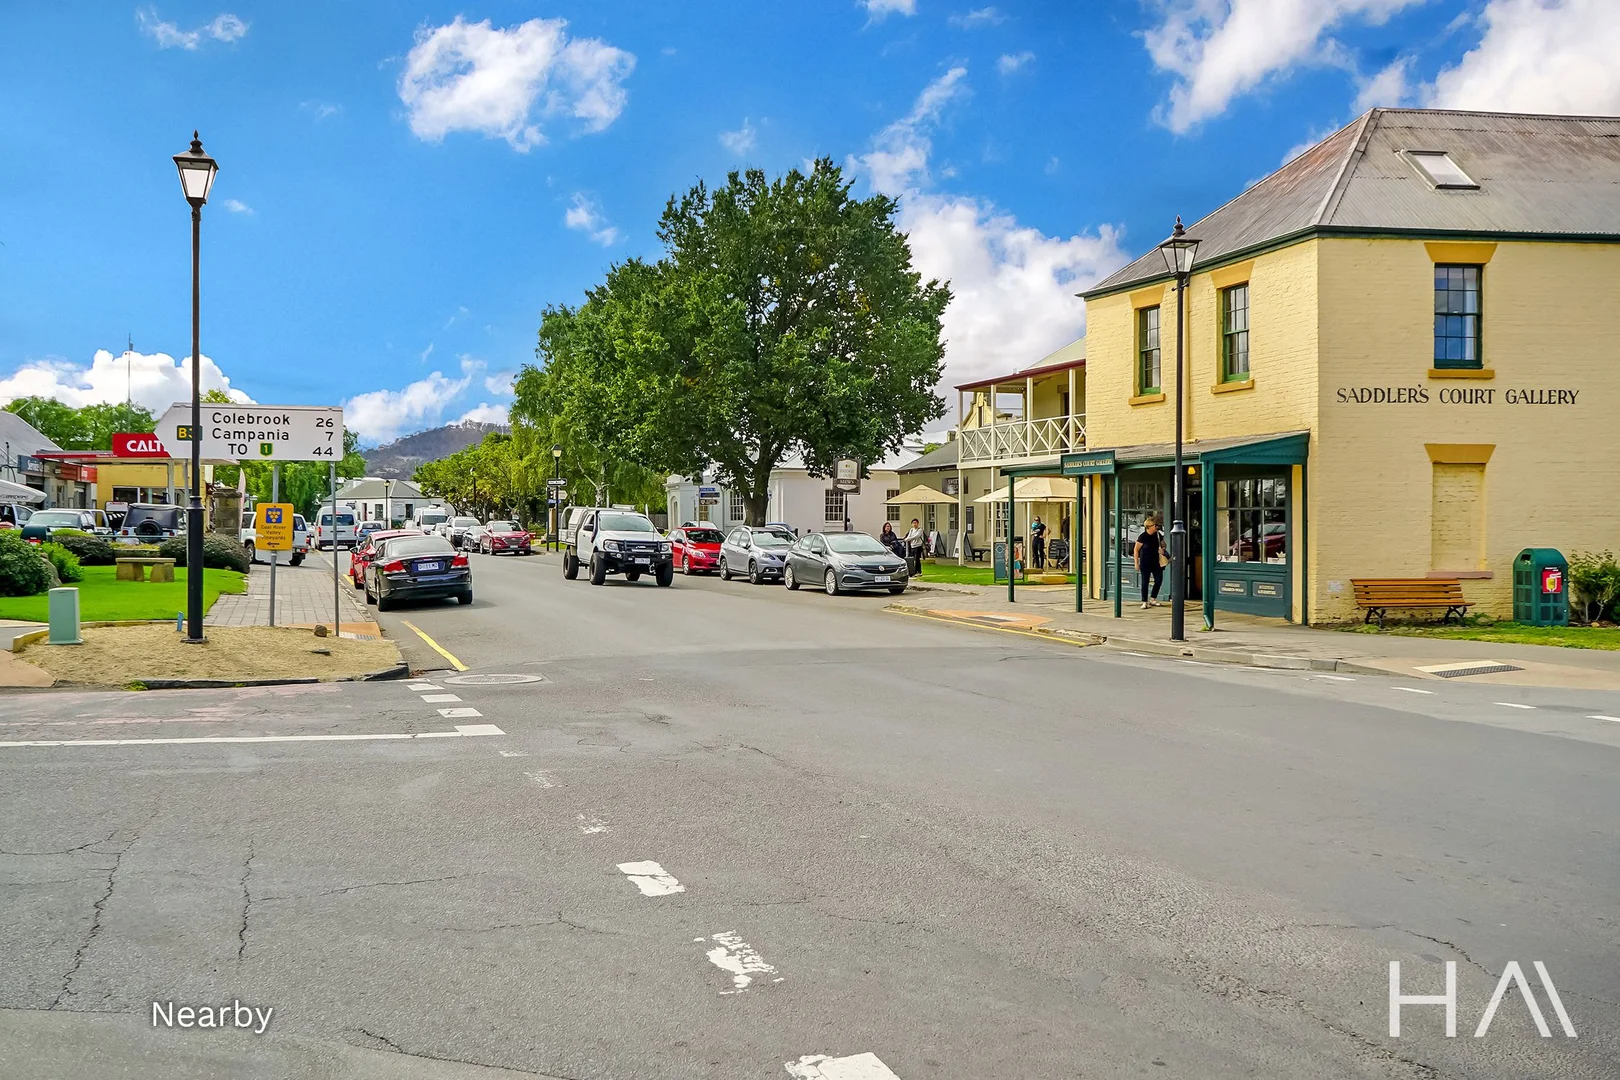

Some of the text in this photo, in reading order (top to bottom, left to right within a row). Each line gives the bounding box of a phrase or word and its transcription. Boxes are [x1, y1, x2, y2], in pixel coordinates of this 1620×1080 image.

[1336, 384, 1580, 405] SADDLER'S COURT GALLERY
[212, 412, 334, 427] Colebrook 26
[212, 428, 334, 442] Campania 7
[126, 440, 167, 452] CALT
[228, 444, 248, 455] TO
[312, 447, 334, 456] 44
